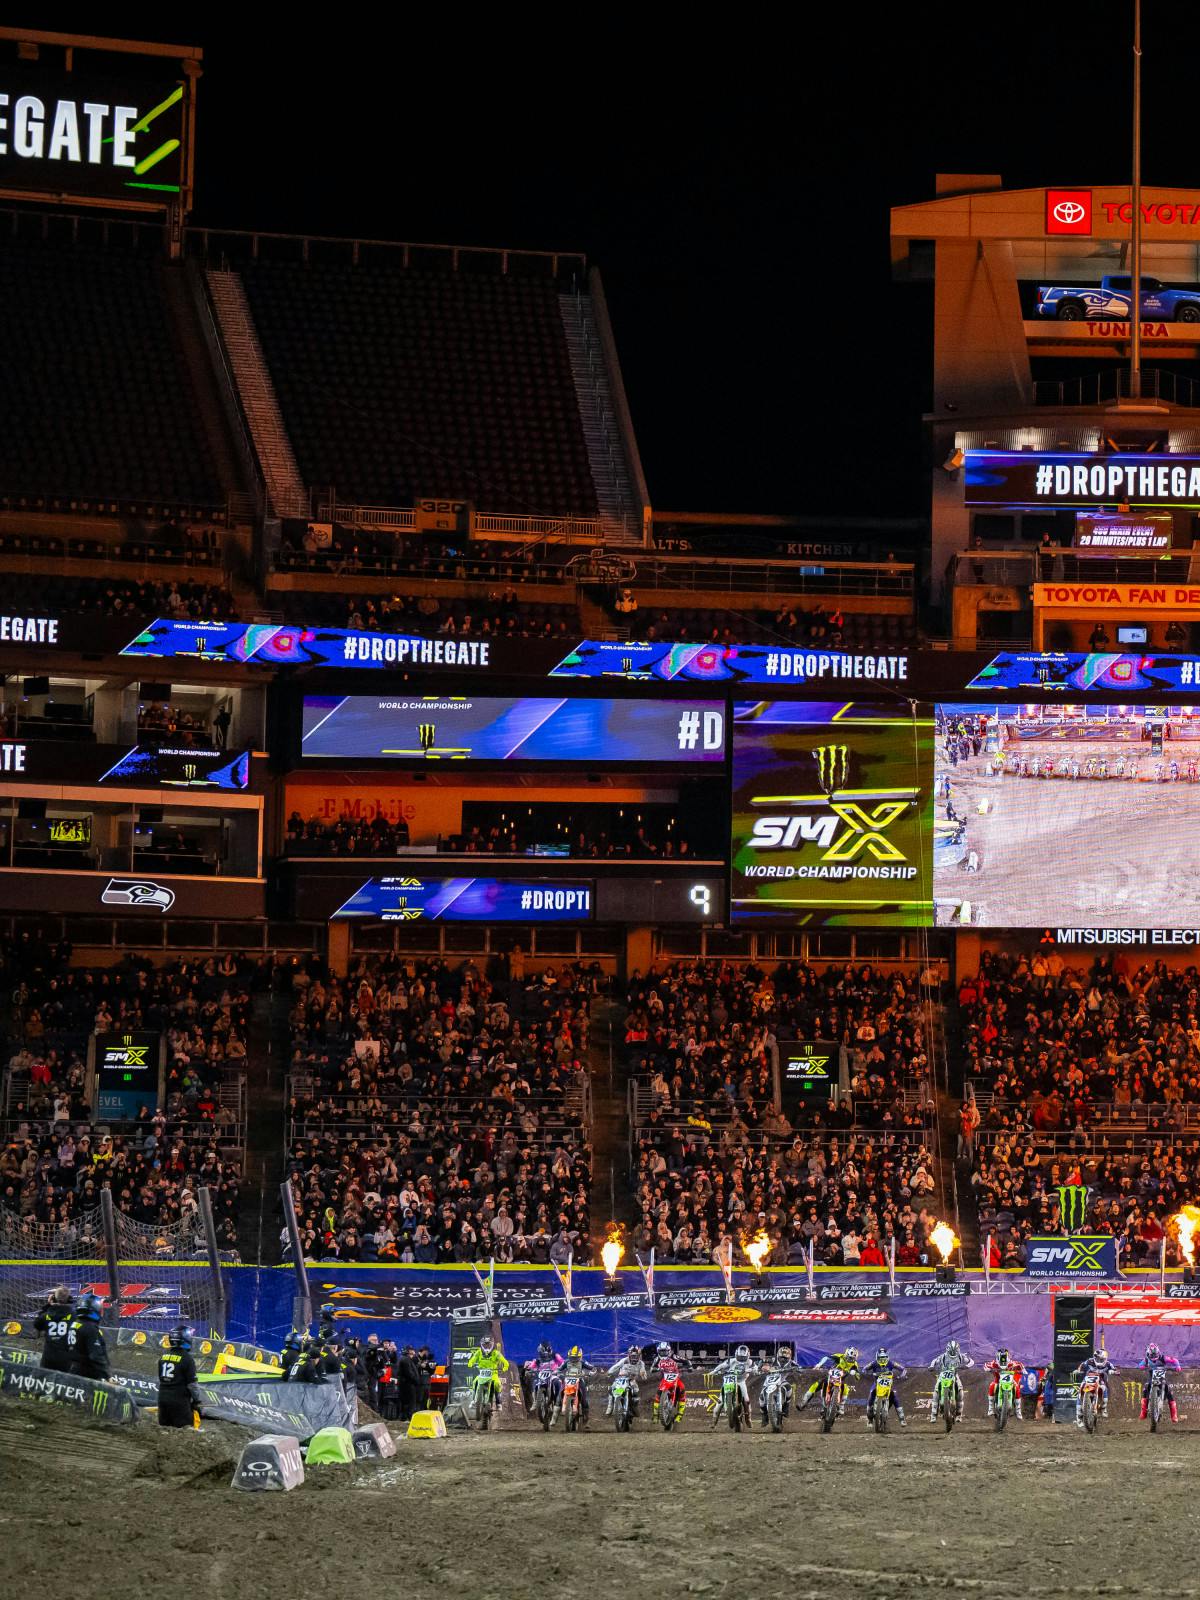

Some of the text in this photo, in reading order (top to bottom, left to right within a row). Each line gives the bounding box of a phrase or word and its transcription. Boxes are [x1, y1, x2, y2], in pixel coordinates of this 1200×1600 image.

[1087, 322, 1169, 337] TUNRA
[787, 543, 852, 555] KITCHEN
[1153, 537, 1167, 546] LAP
[1043, 587, 1121, 603] TOYOTA
[1129, 588, 1166, 603] FAN
[344, 635, 489, 666] #DROPTHEGATE
[766, 653, 908, 680] #DROPTHEGATE
[410, 702, 472, 710] CHAMPIONSHIP
[678, 711, 723, 750] #D
[747, 801, 909, 861] SMX
[744, 866, 917, 879] WORLD CHAMPIONSHIP
[1057, 929, 1147, 945] MITSUBISHI
[104, 1050, 146, 1065] SMX
[787, 1060, 828, 1075] SMX
[1029, 1242, 1106, 1270] SMX
[48, 1321, 68, 1336] 28
[1057, 1332, 1089, 1346] SMX
[162, 1362, 175, 1378] 12
[10, 1373, 85, 1402] MONSTER
